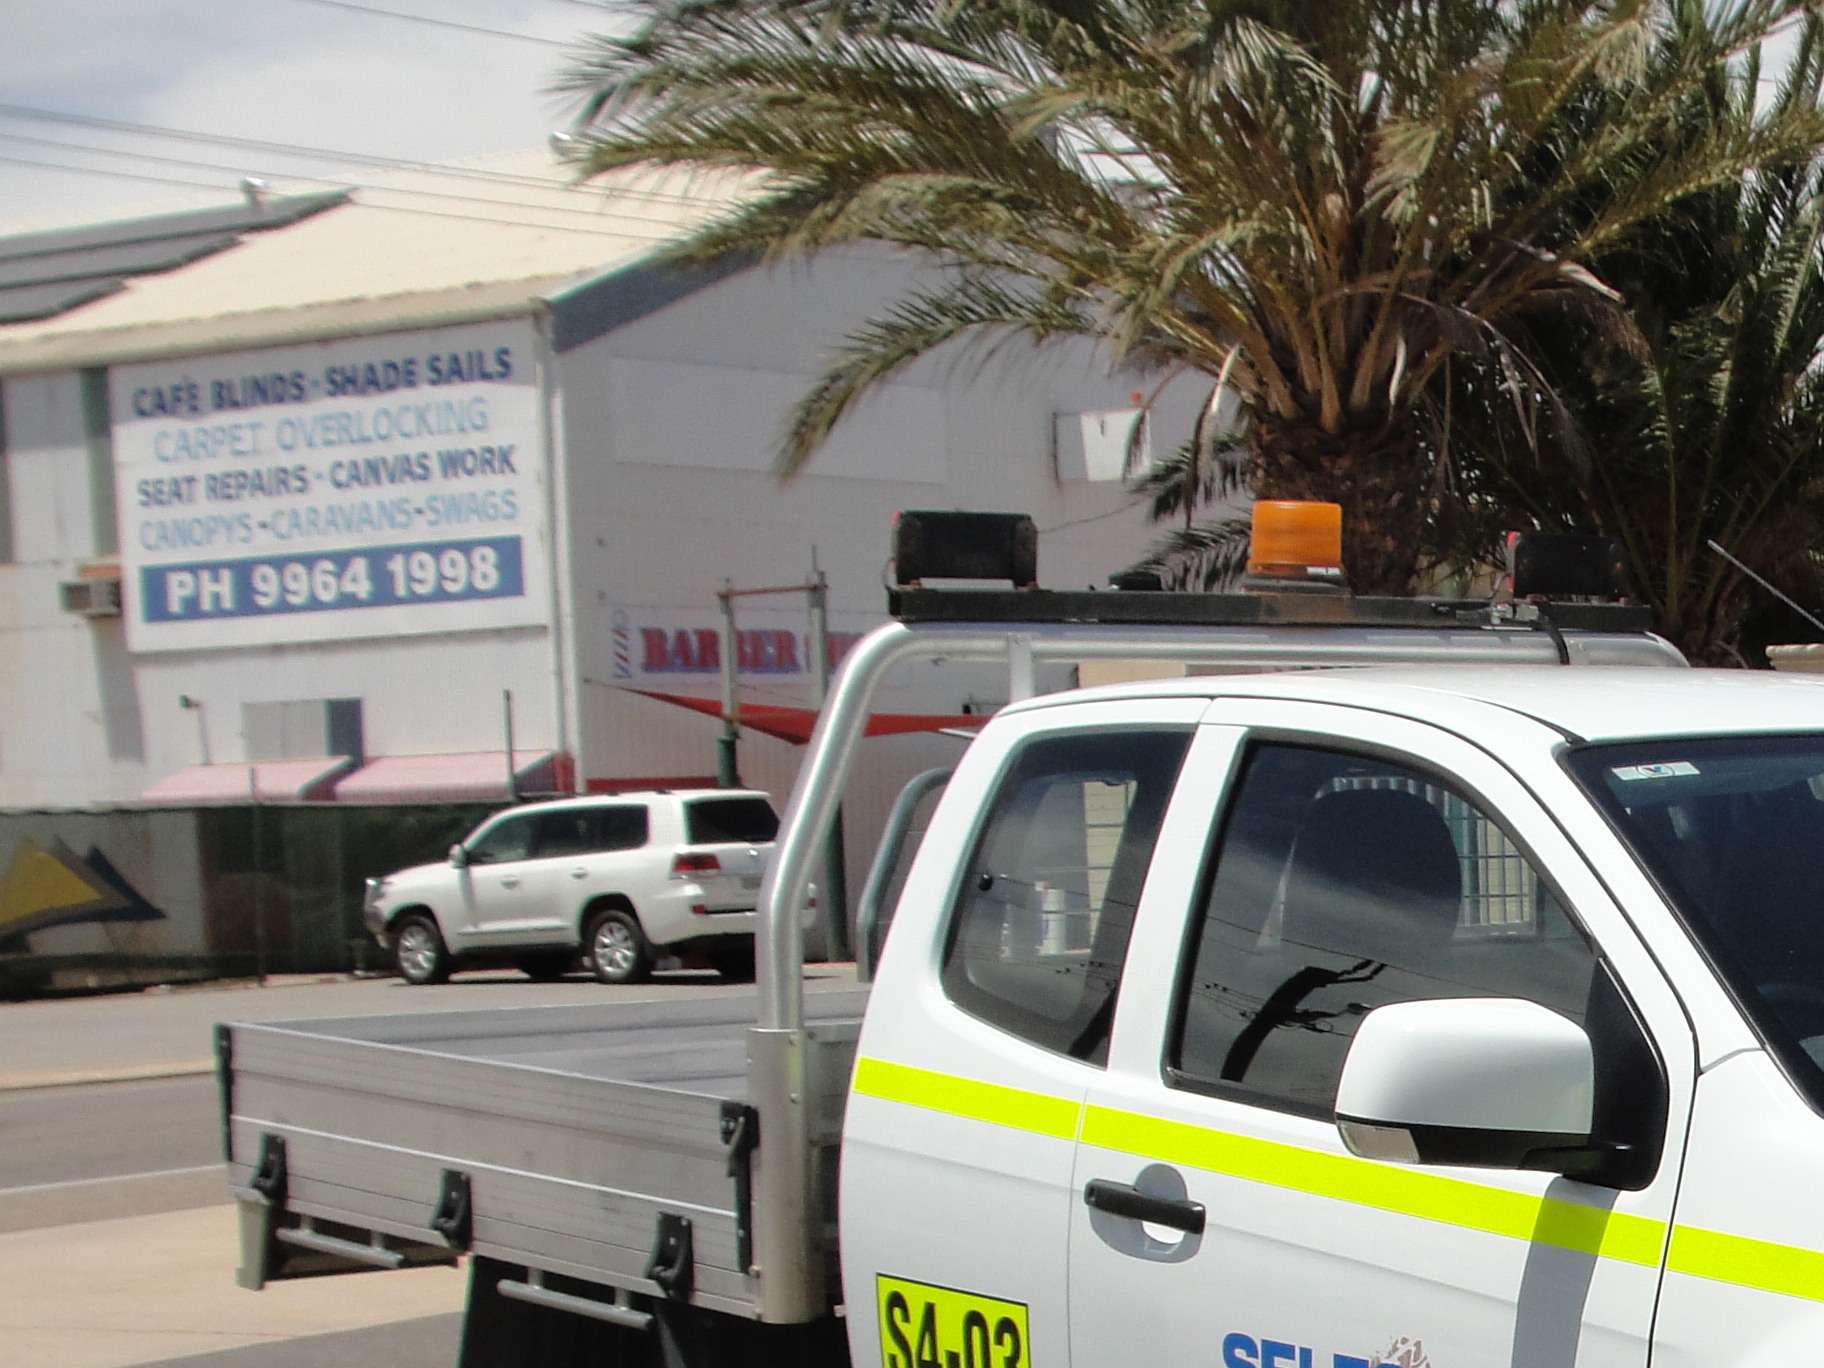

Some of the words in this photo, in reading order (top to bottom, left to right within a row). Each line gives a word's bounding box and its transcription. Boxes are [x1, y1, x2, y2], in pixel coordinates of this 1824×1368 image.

[210, 368, 305, 411] BLINDS
[324, 356, 417, 398] SHADE
[425, 346, 512, 386] SAILS
[153, 419, 264, 464] CARPET
[275, 395, 489, 453] OVERLOCKING
[136, 474, 197, 507] SEAT
[204, 463, 310, 502] REPAIRS
[328, 451, 431, 489] CANVAS
[435, 443, 517, 479] WORK
[164, 567, 236, 616] PH
[252, 556, 374, 608] 9964
[386, 544, 500, 599] 1998
